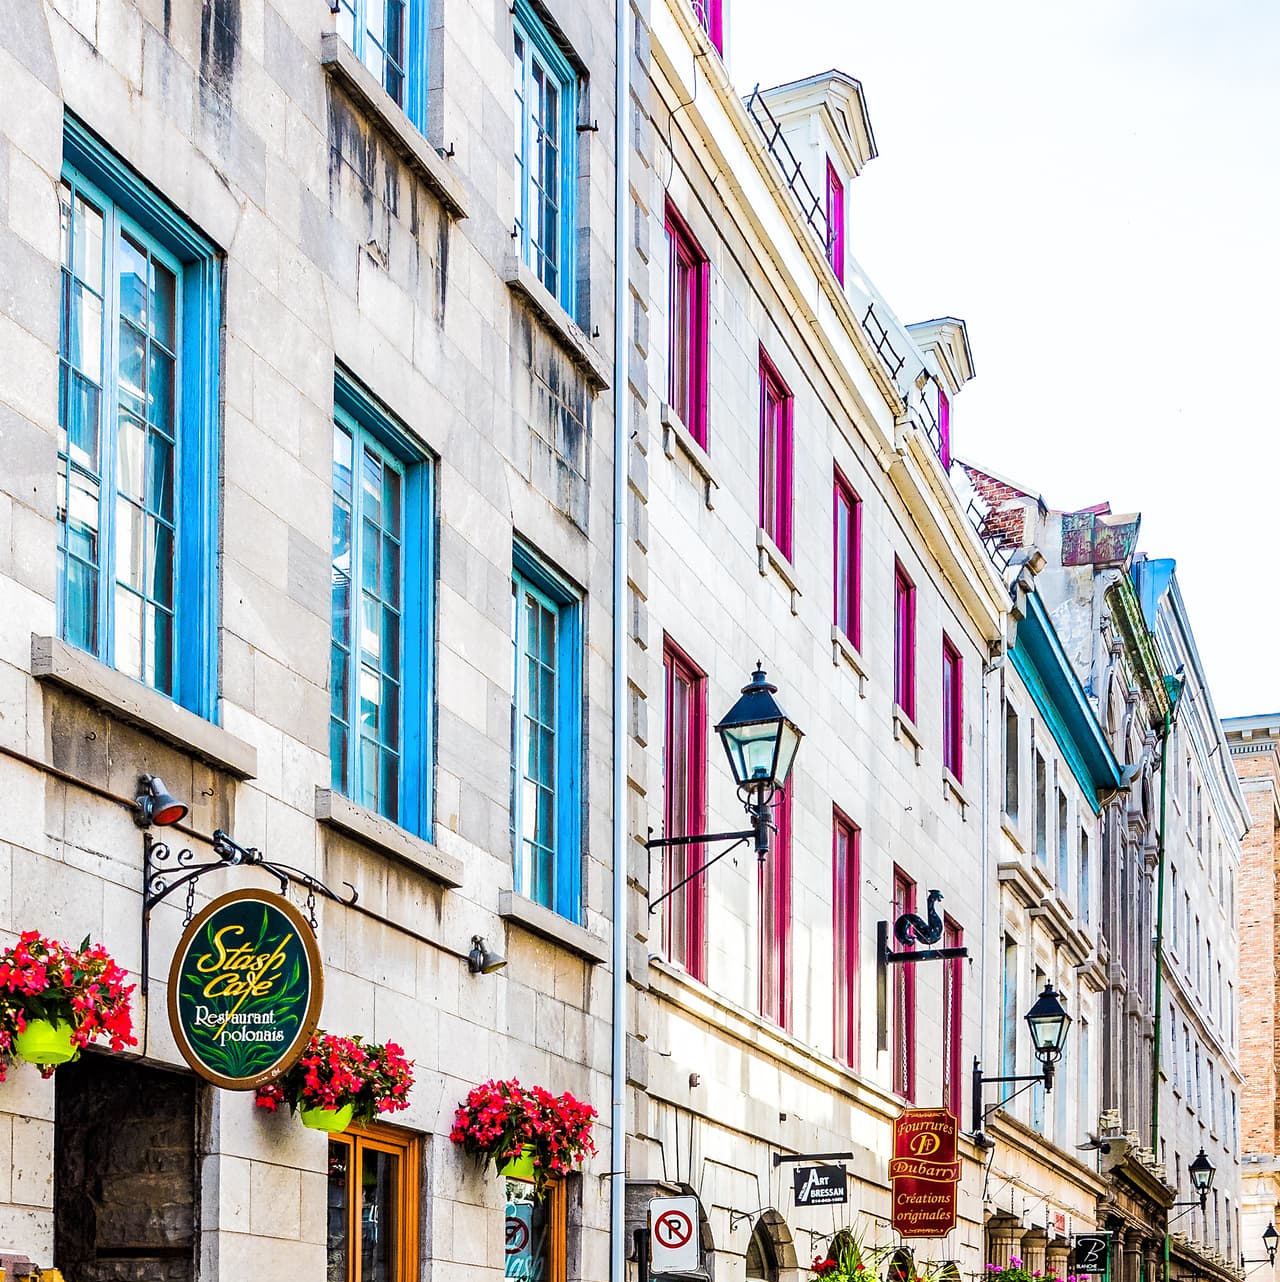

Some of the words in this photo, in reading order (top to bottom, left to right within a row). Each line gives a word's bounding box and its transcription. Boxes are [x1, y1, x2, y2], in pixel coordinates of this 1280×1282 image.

[197, 925, 293, 973] Stash
[194, 1006, 276, 1027] Restaurant
[220, 1026, 285, 1046] polonais
[898, 1121, 953, 1136] Fourrures
[893, 1161, 957, 1180] Dubarry
[810, 1187, 844, 1198] BRESSAN
[897, 1192, 952, 1205] Créations
[896, 1208, 952, 1224] originales
